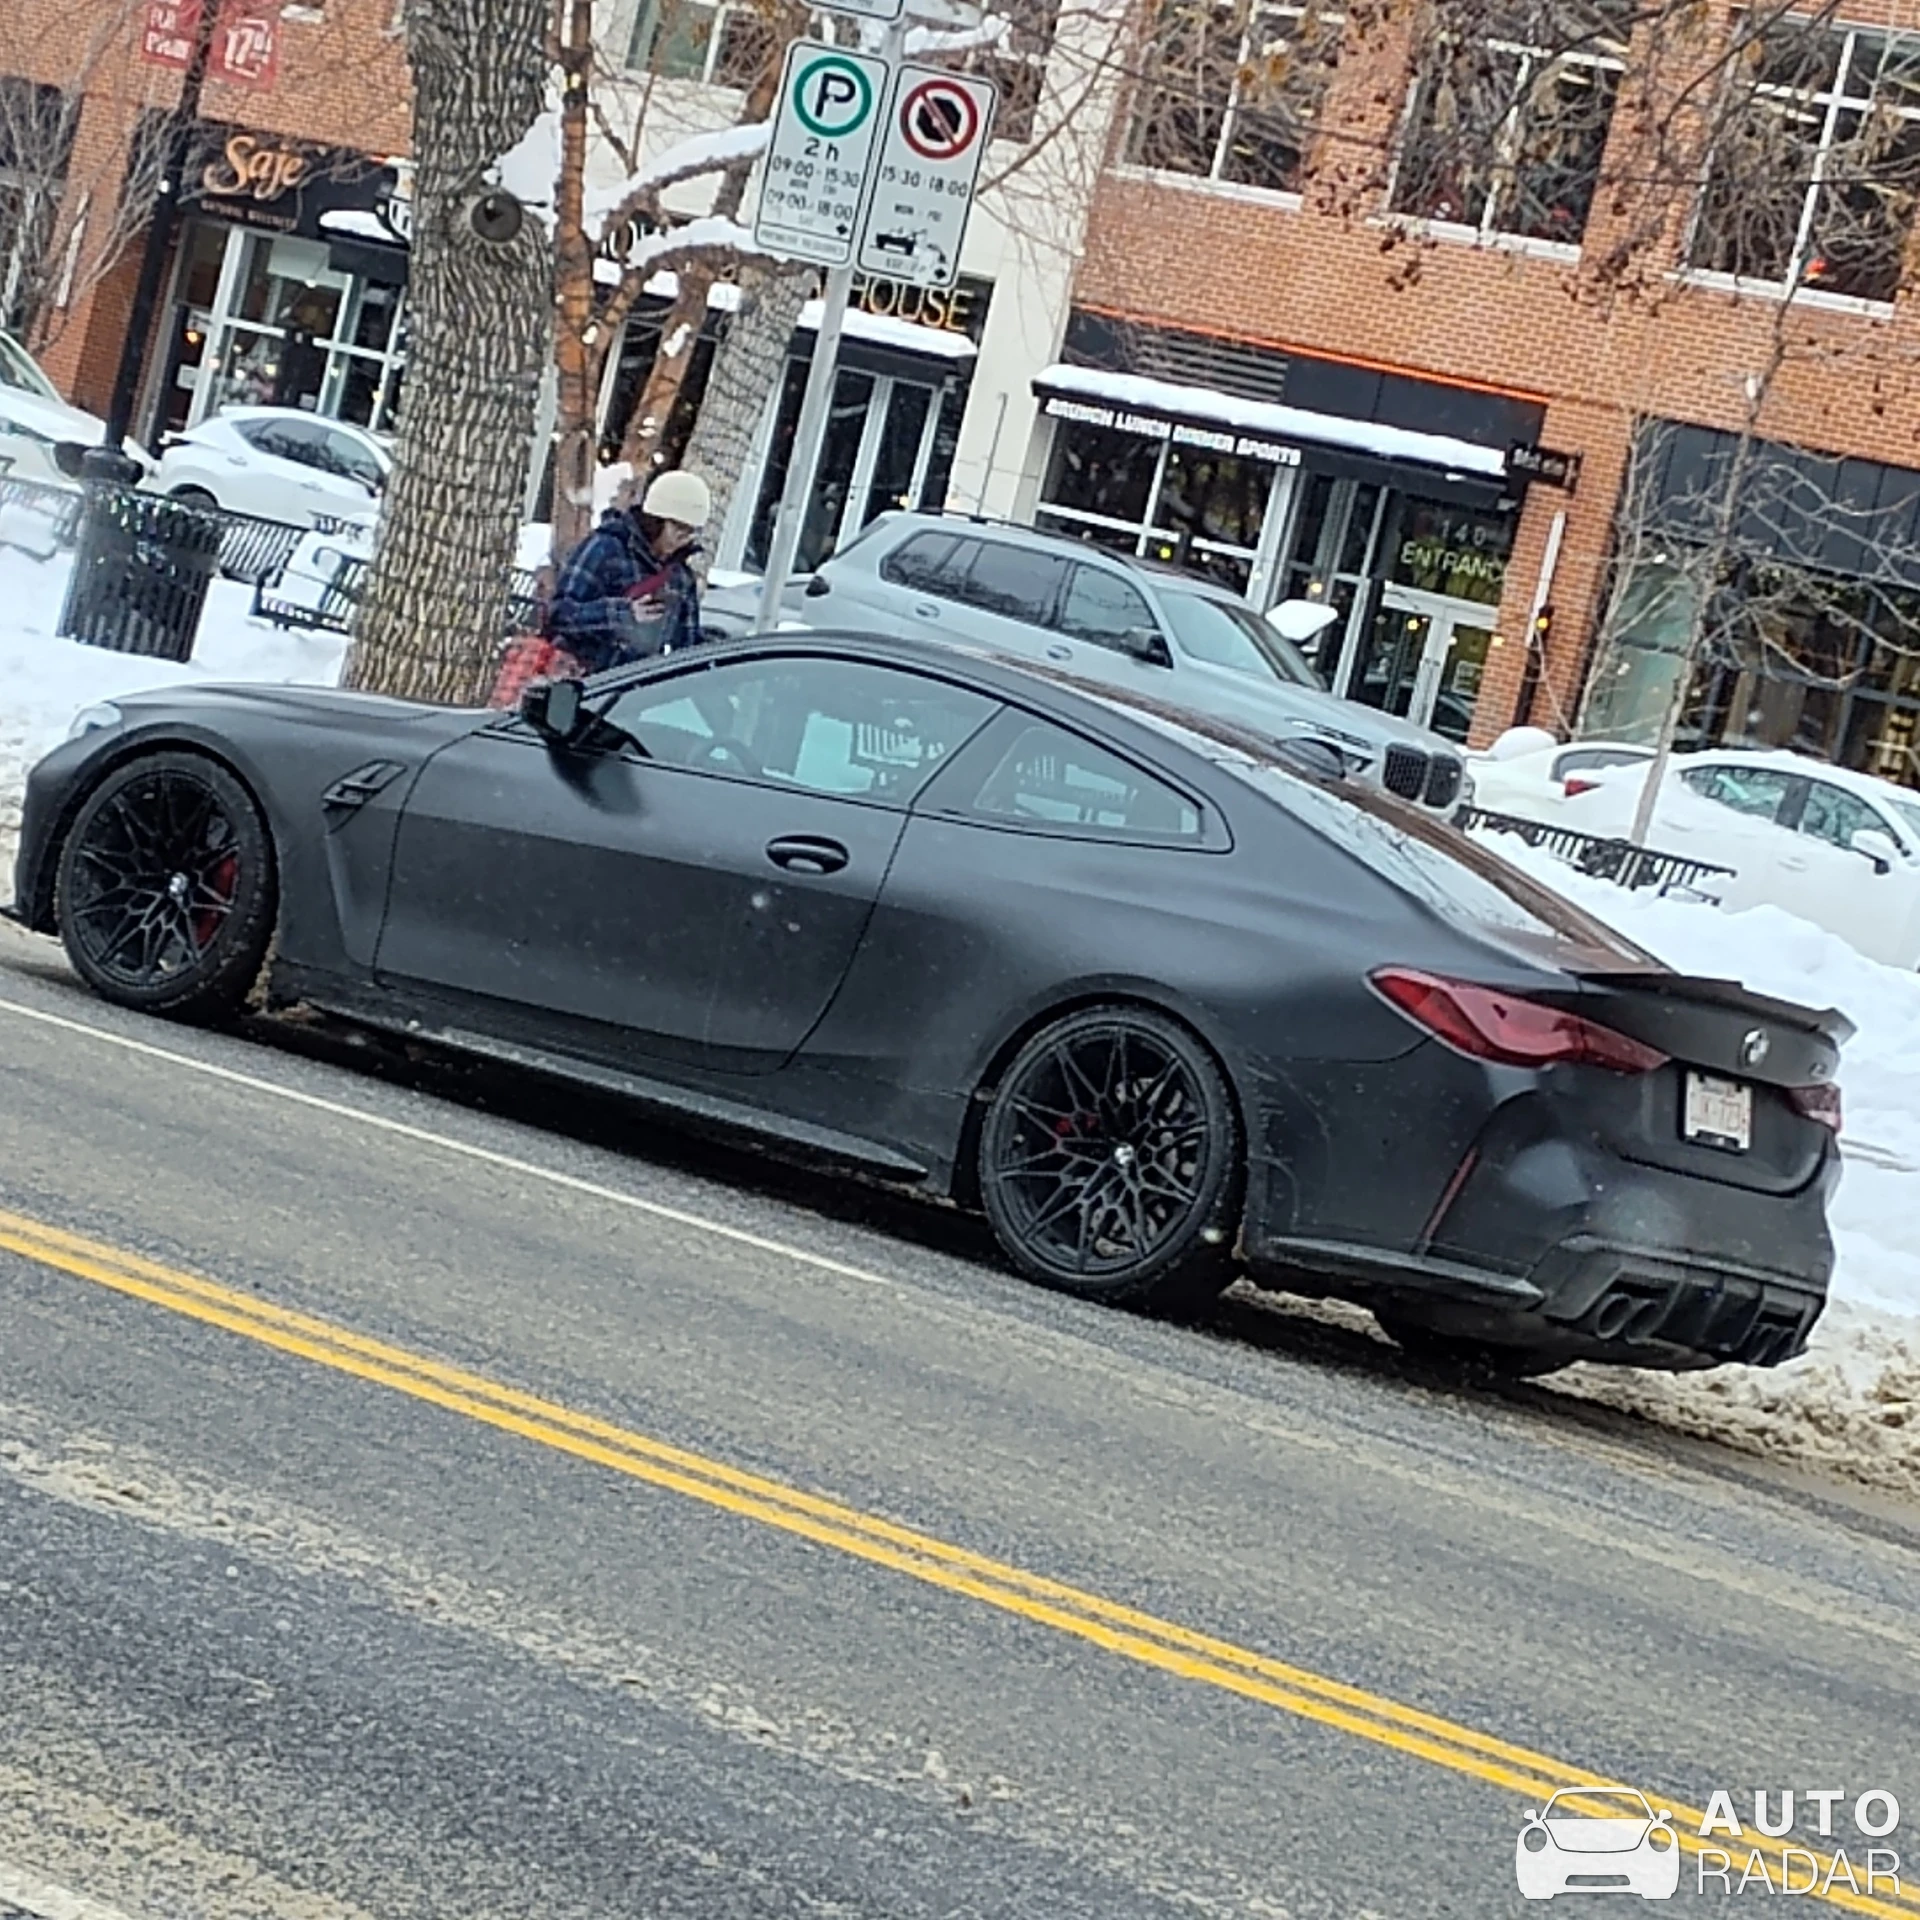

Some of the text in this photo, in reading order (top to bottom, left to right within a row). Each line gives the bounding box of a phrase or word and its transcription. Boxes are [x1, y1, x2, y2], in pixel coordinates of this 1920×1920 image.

[815, 72, 856, 117] P
[204, 136, 304, 200] Saje
[804, 136, 839, 162] 2 h
[1400, 540, 1506, 583] ENTRANC
